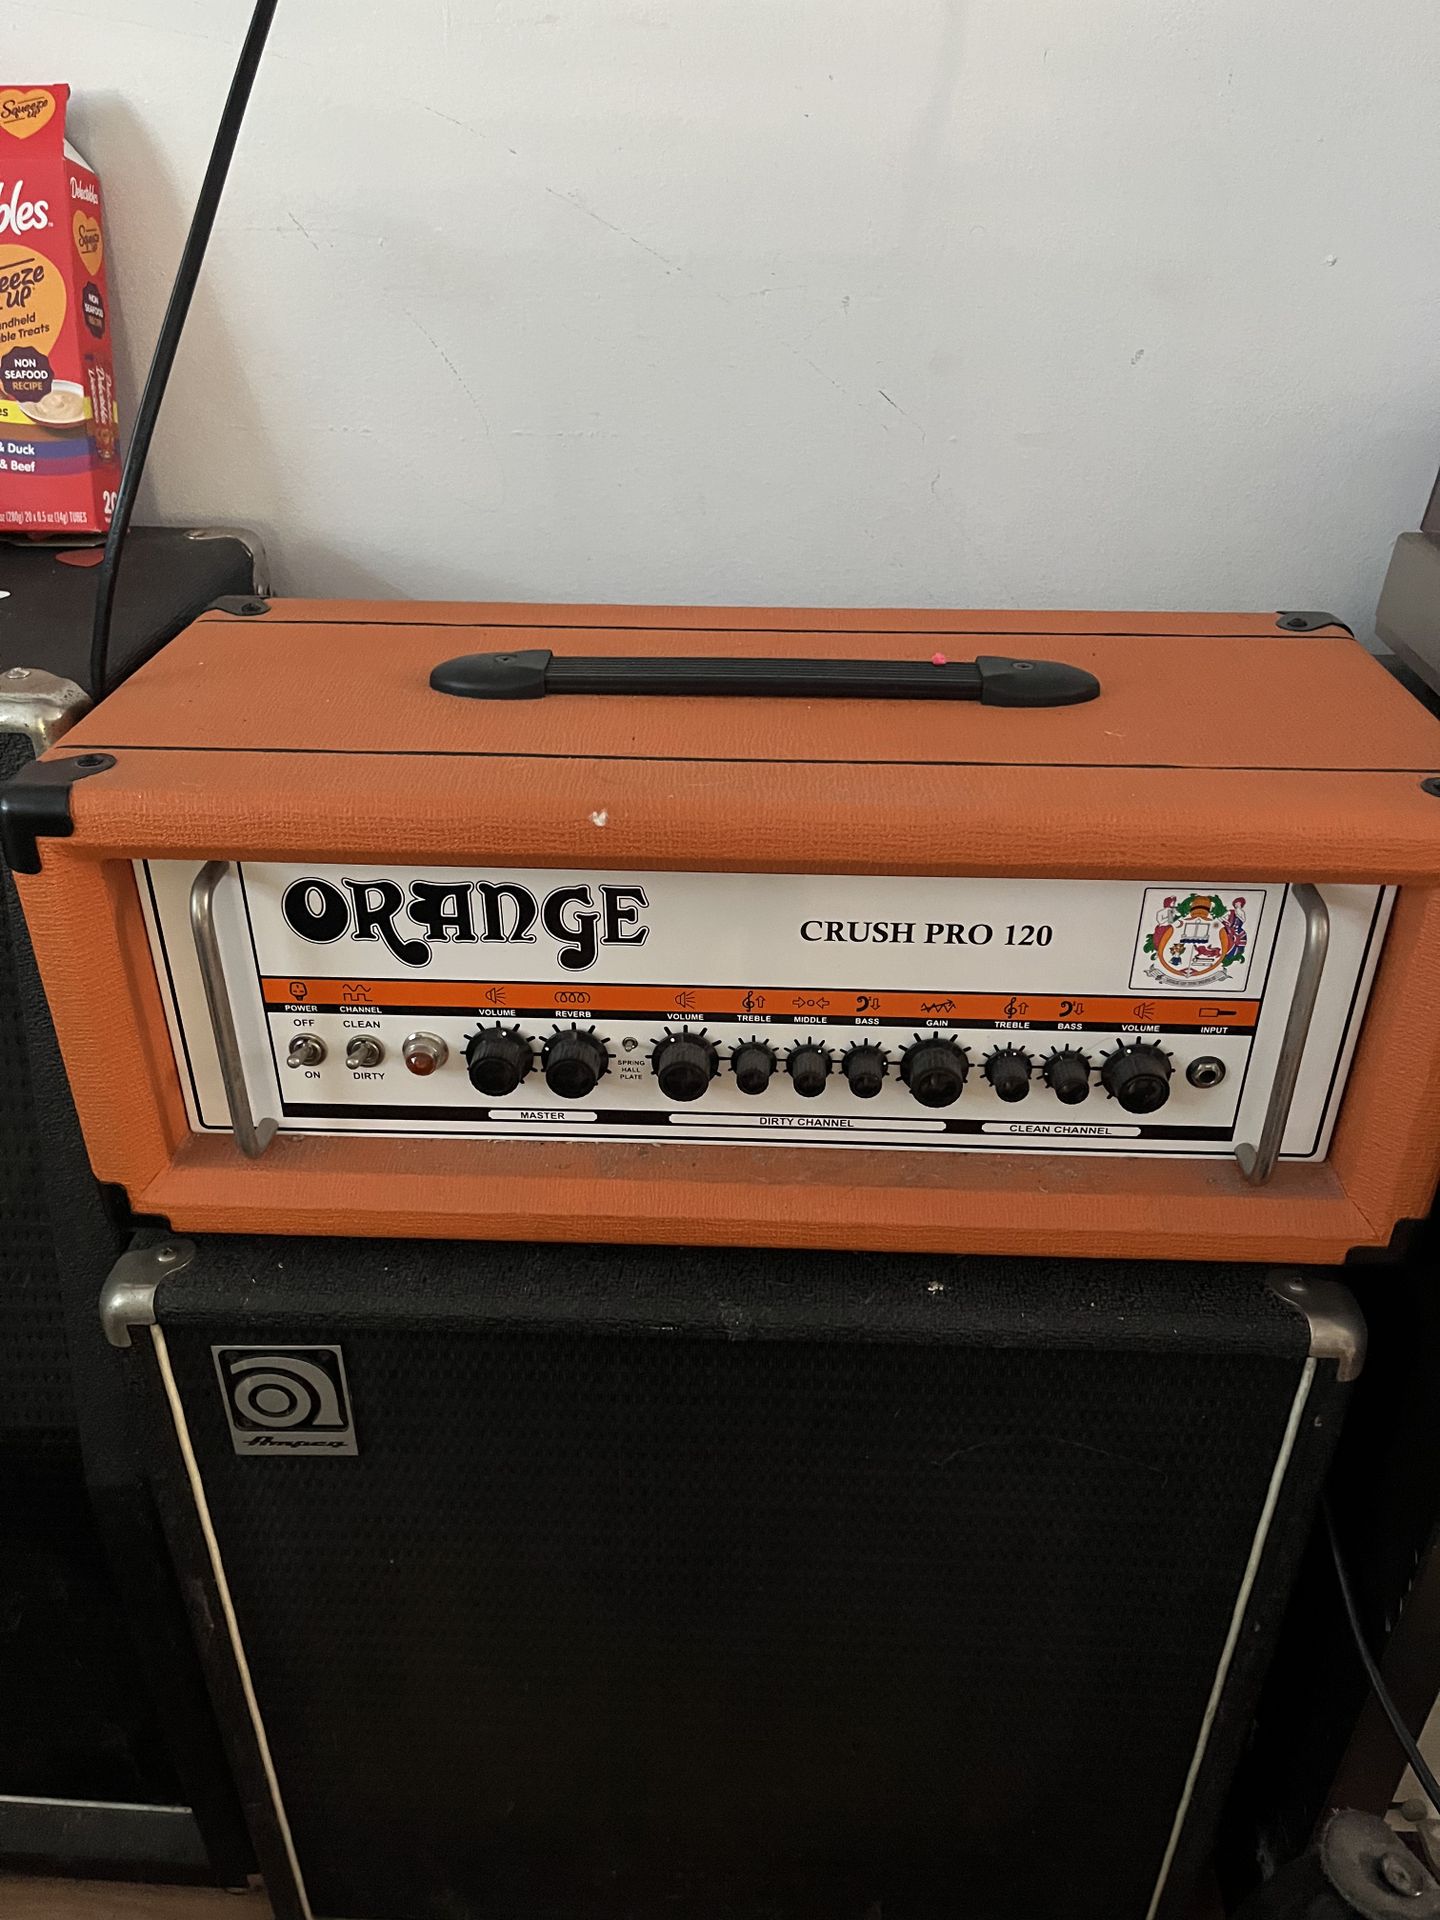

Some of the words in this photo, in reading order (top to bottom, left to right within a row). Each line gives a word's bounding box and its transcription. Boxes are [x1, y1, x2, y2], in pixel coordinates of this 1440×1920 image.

[1, 99, 48, 118] Squeeze
[18, 324, 50, 338] Treats
[14, 358, 36, 368] NON
[4, 369, 48, 380] SEAFOOD
[12, 380, 43, 391] RECIPE
[7, 443, 36, 456] Duck
[10, 460, 36, 473] Beef
[25, 512, 32, 523] 20
[69, 511, 88, 524] TUBES
[281, 877, 650, 971] ORANGE
[799, 920, 916, 944] CRUSH
[922, 922, 994, 946] PRO
[1004, 925, 1054, 948] 120
[284, 1004, 319, 1013] POWER
[339, 1005, 383, 1014] CHANNEL
[478, 1008, 517, 1017] VOLUME
[554, 1010, 592, 1019] REVERB
[666, 1013, 704, 1021] VOLUME
[736, 1014, 772, 1023] TREBLE
[293, 1018, 316, 1027] OFF
[342, 1019, 382, 1029] CLEAN
[793, 1016, 828, 1024] MIDDLE
[855, 1017, 880, 1026] BASS
[925, 1019, 949, 1027] GAIN
[994, 1021, 1031, 1030] TREBLE
[1057, 1023, 1083, 1031] BASS
[1121, 1024, 1161, 1033] VOLUME
[1200, 1026, 1229, 1035] INPUT
[304, 1070, 322, 1079] ON
[352, 1071, 387, 1081] DIRTY
[519, 1110, 566, 1121] MASTER
[759, 1116, 794, 1126] DIRTY
[797, 1116, 854, 1128] CHANNEL
[1009, 1124, 1051, 1134] CLEAN
[1053, 1124, 1113, 1136] CHANNEL
[242, 1436, 349, 1449] Ampeg
